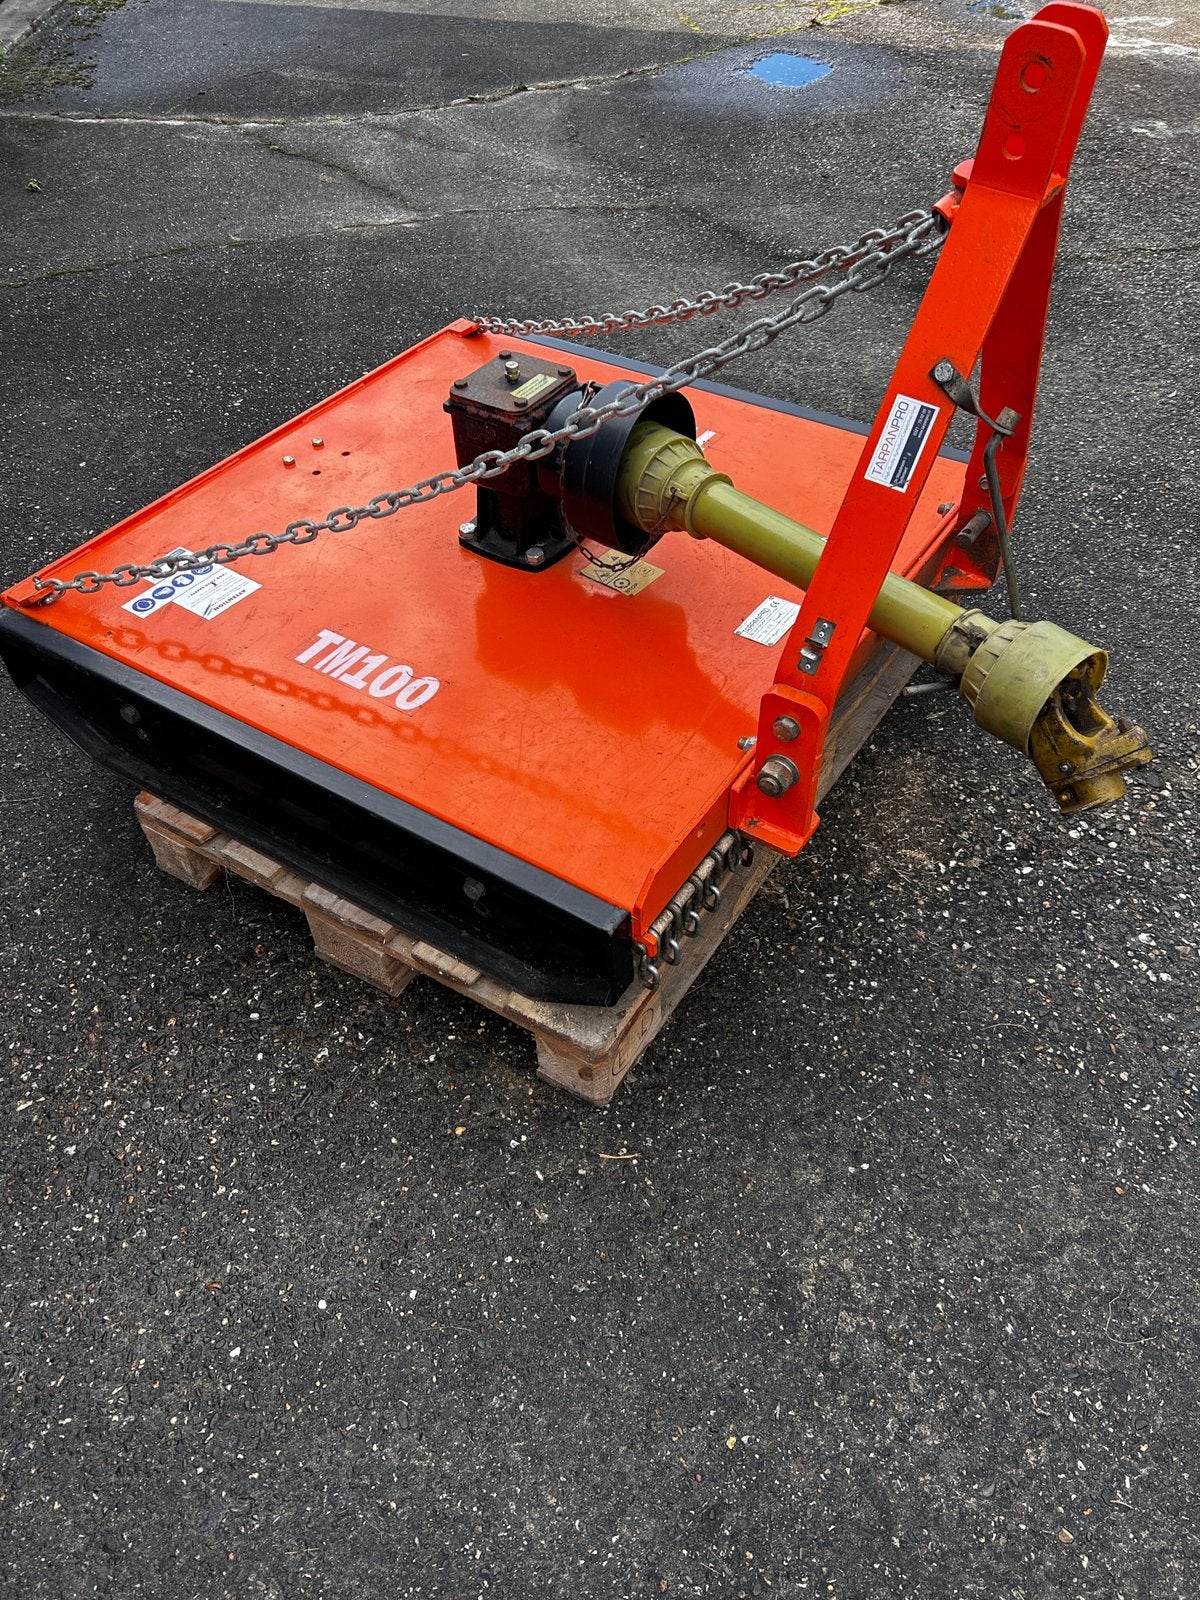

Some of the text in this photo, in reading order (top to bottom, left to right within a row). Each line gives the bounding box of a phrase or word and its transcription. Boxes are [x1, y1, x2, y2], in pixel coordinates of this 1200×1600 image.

[871, 401, 909, 476] TARPANPRO
[212, 589, 246, 610] ATTENTION
[294, 629, 441, 710] TM100
